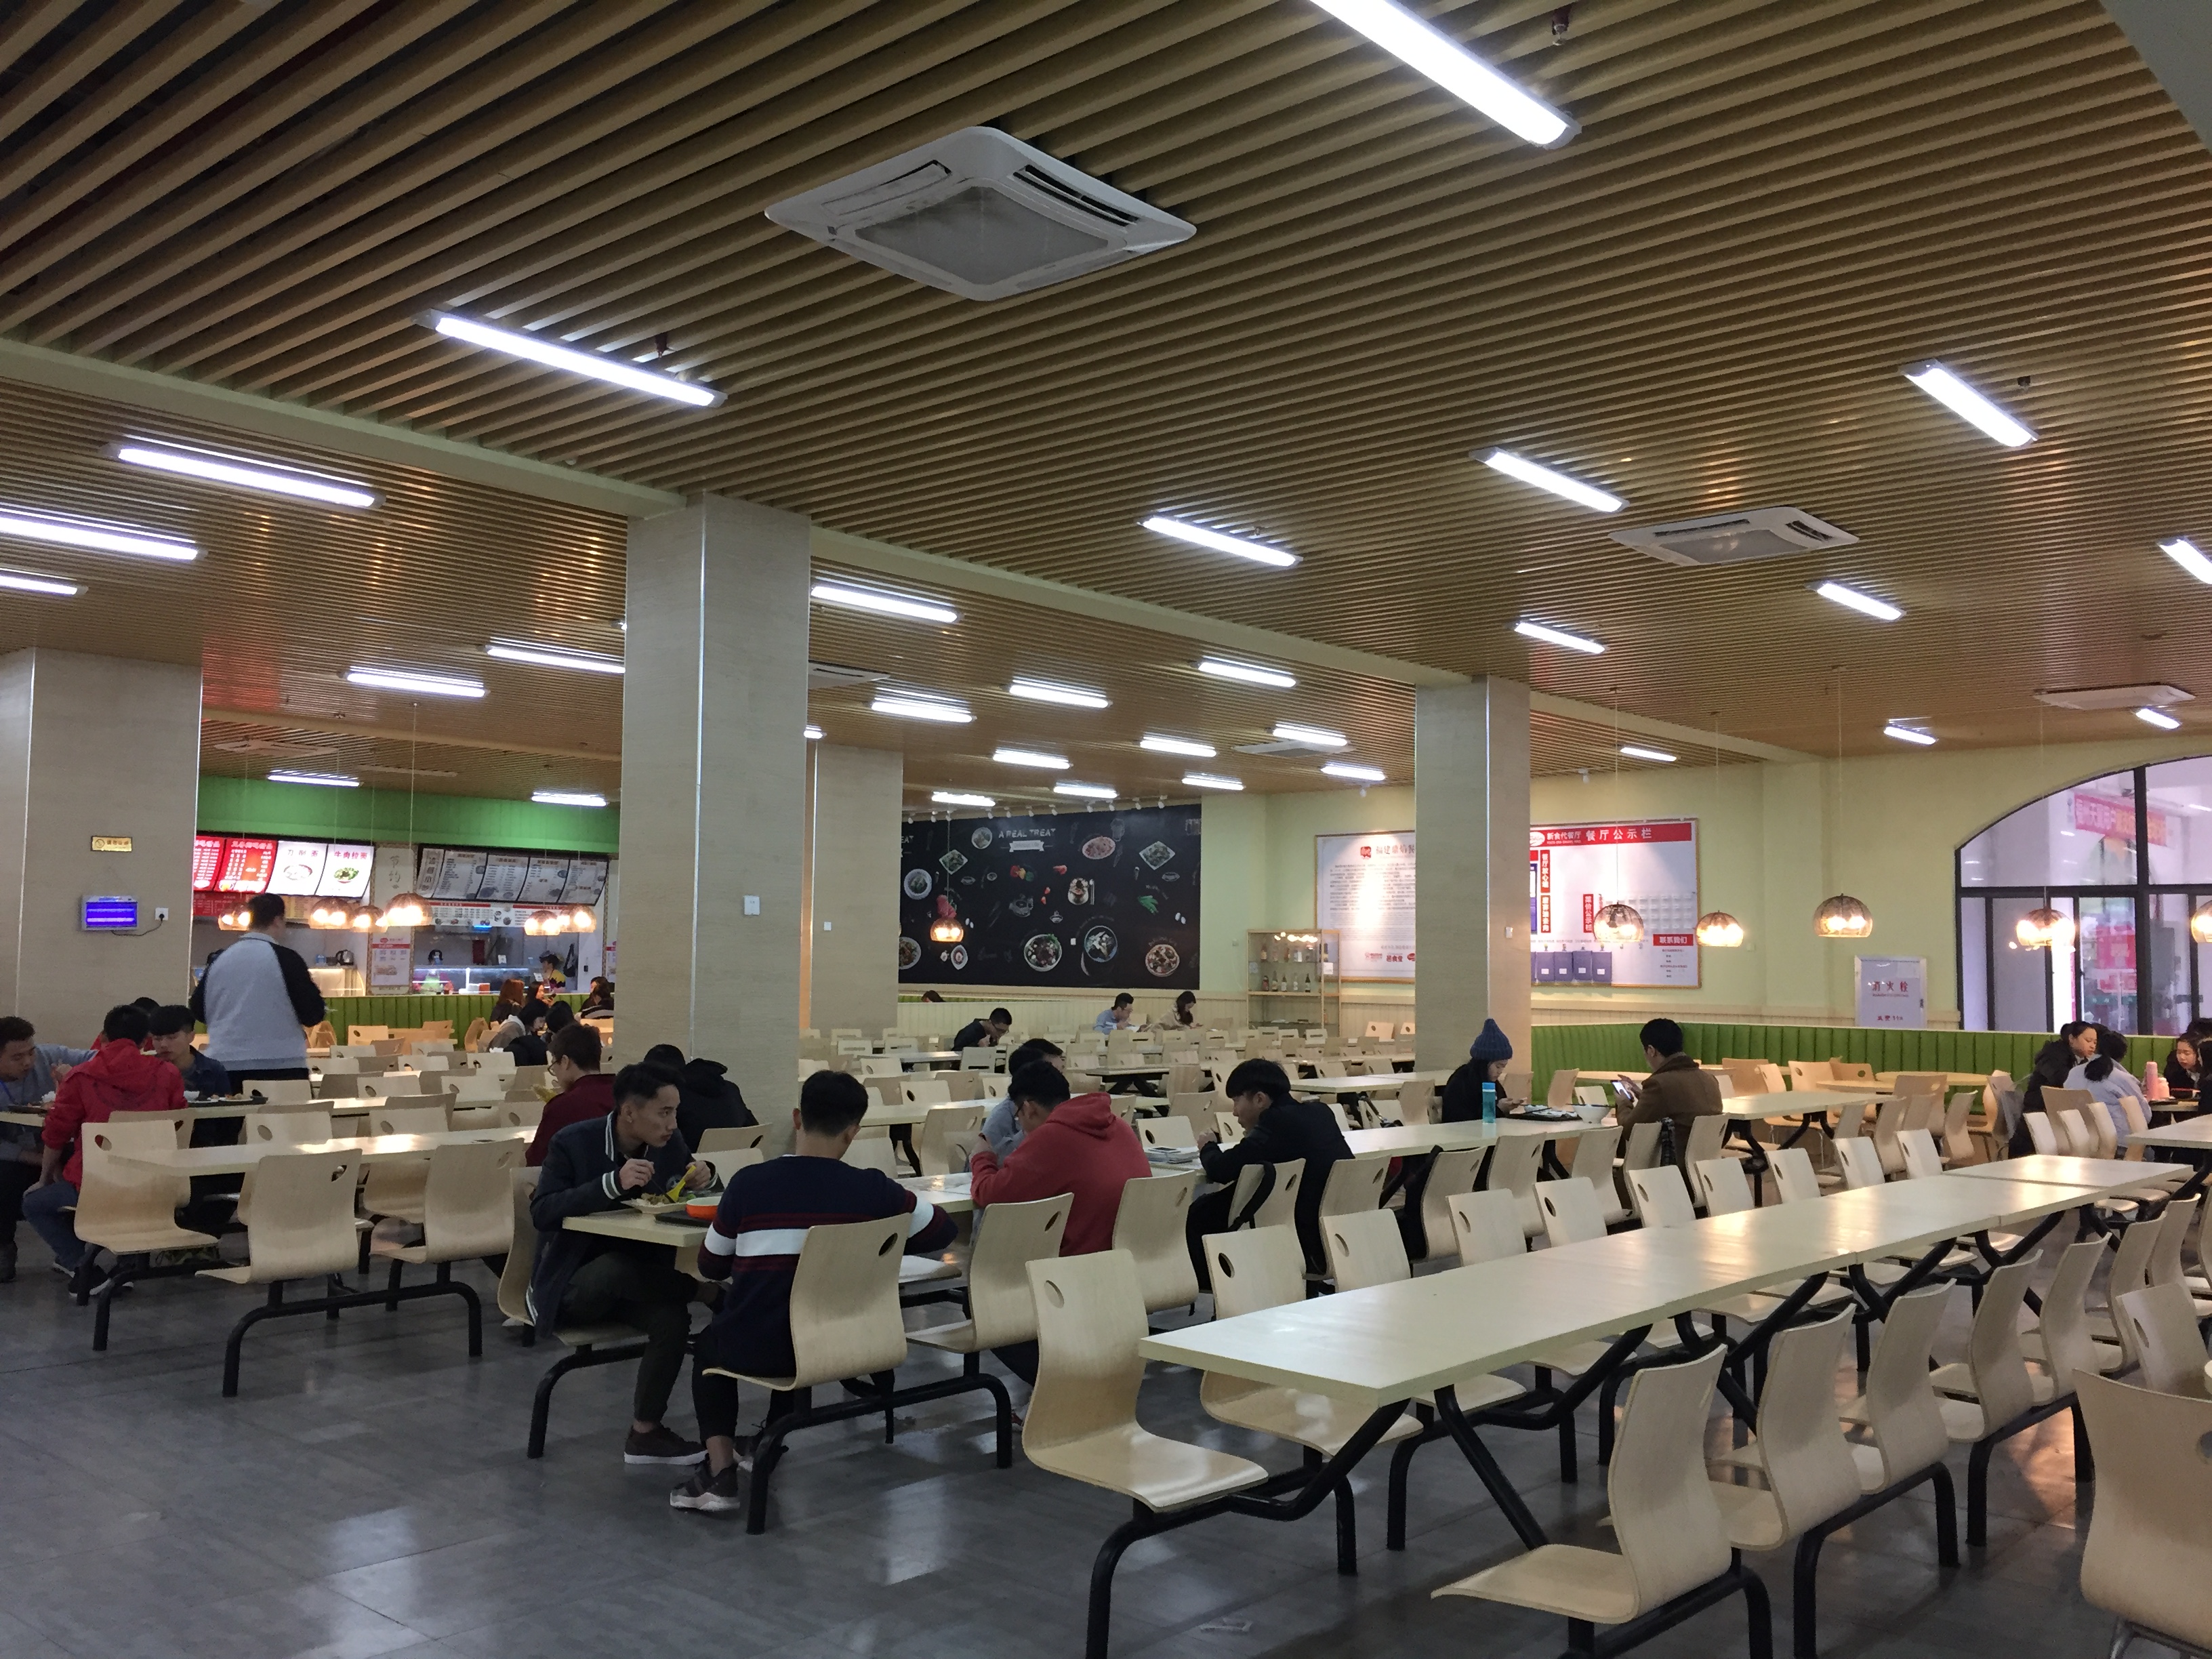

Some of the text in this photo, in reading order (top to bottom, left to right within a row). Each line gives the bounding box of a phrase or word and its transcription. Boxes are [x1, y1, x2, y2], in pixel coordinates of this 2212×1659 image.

[998, 828, 1056, 838] A REAL TREAT
[1547, 831, 1581, 840] 新食代餐厅
[1586, 827, 1652, 842] 餐厅公示栏
[334, 851, 368, 859] 牛肉拉面
[1659, 936, 1687, 945] 联系我们
[1871, 981, 1908, 992] 消火栓
